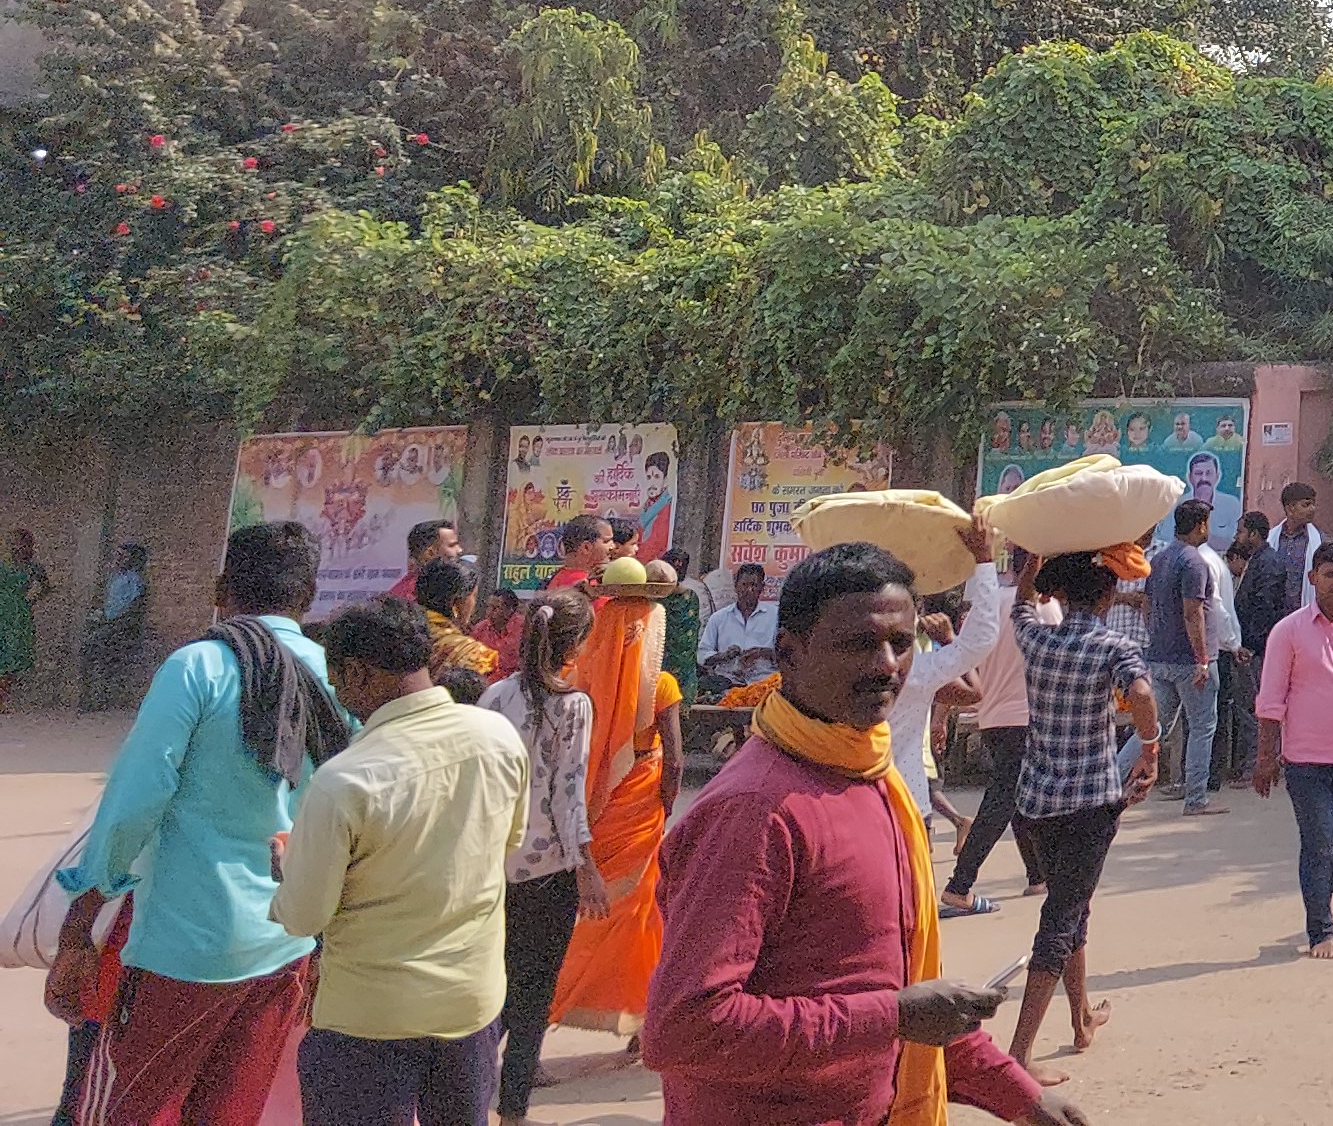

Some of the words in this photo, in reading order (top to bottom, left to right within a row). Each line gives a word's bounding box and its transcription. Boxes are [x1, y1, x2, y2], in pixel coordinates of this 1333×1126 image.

[607, 461, 636, 485] हार्दिक
[733, 517, 762, 534] हार्दिक
[730, 538, 769, 564] सर्वेश
[772, 541, 811, 571] कुमा
[502, 564, 531, 583] राहुल
